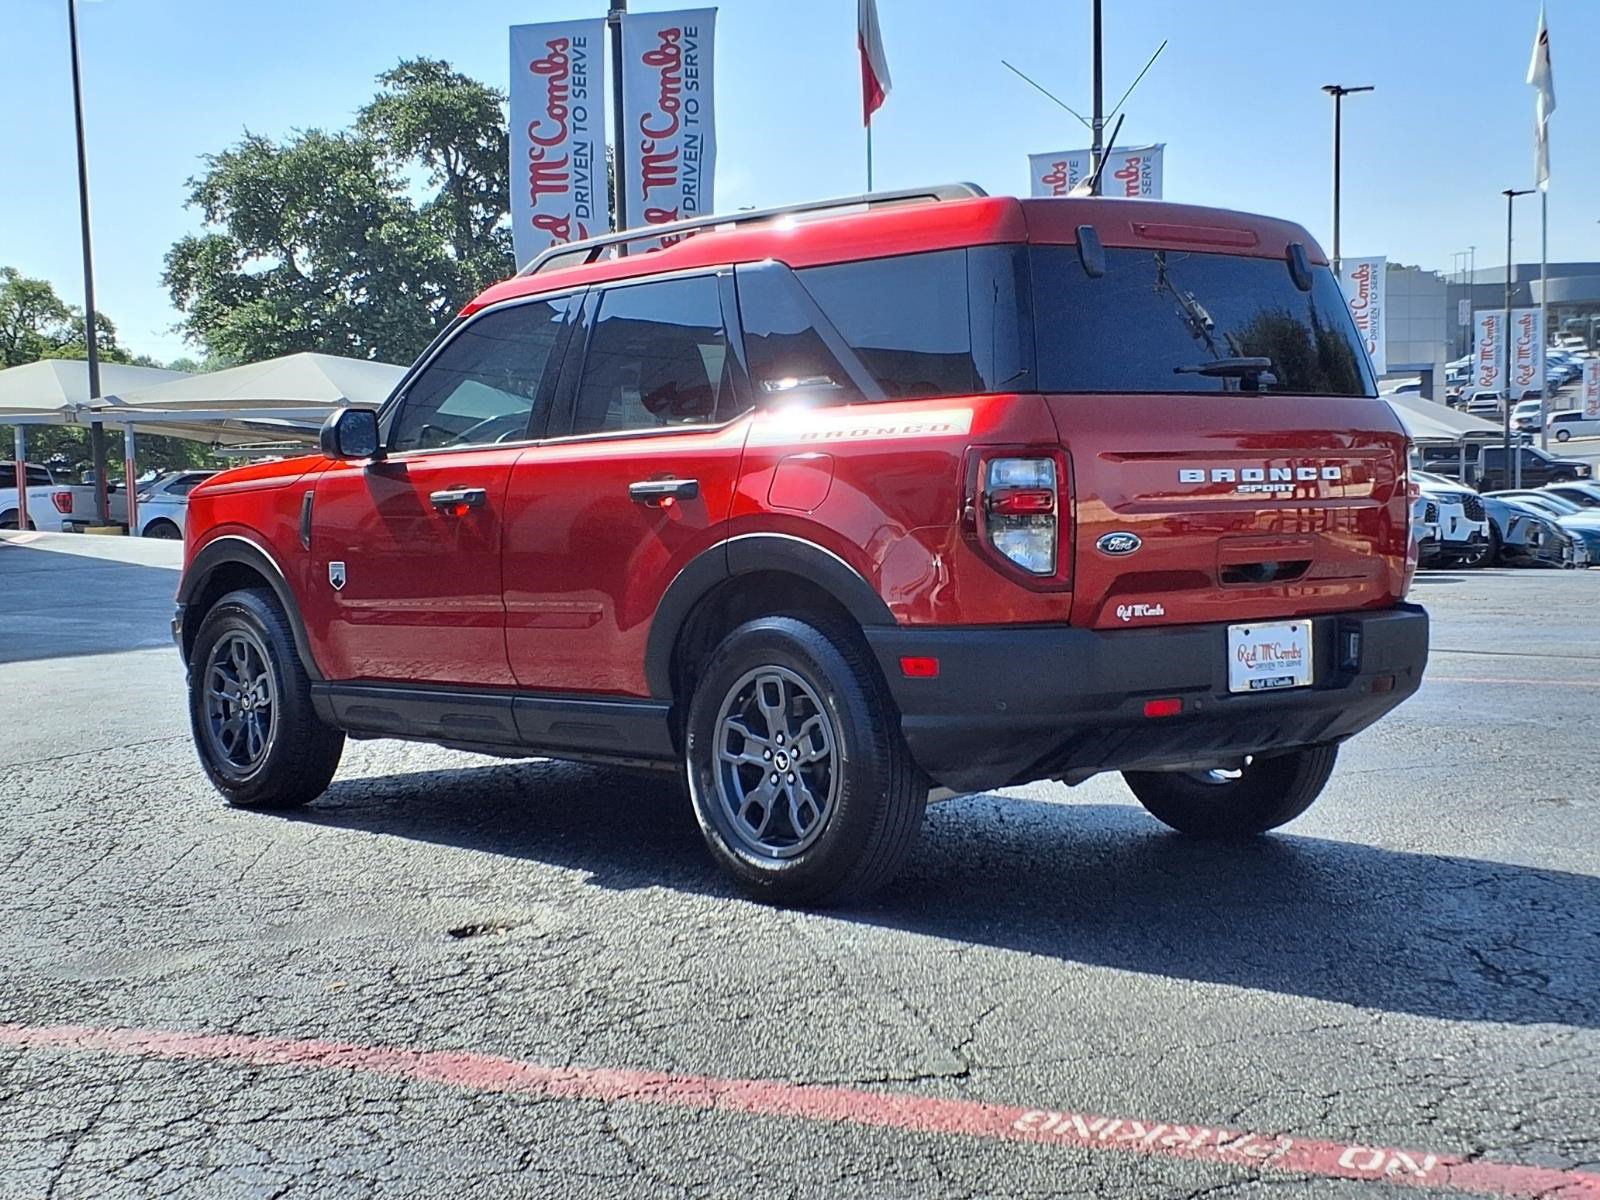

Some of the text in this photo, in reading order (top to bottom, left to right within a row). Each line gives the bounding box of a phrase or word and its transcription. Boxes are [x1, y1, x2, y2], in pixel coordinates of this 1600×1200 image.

[528, 37, 570, 208] McCombs
[572, 36, 590, 219] DRIVEN TO SERVE
[640, 27, 682, 201] McCombs
[683, 26, 699, 212] DRIVEN TO SERVE
[1069, 159, 1079, 192] ERVE
[1141, 156, 1152, 195] SERVE
[1370, 263, 1378, 291] SERVE
[1370, 293, 1378, 306] TO
[1370, 308, 1378, 340] DRIVEN
[1479, 365, 1499, 387] Red
[1516, 364, 1536, 386] Red
[1179, 466, 1343, 484] BRONCO
[1236, 483, 1298, 494] SPORT
[1237, 640, 1303, 669] Red McCombs
[1013, 1110, 1437, 1178] NO PARKING
